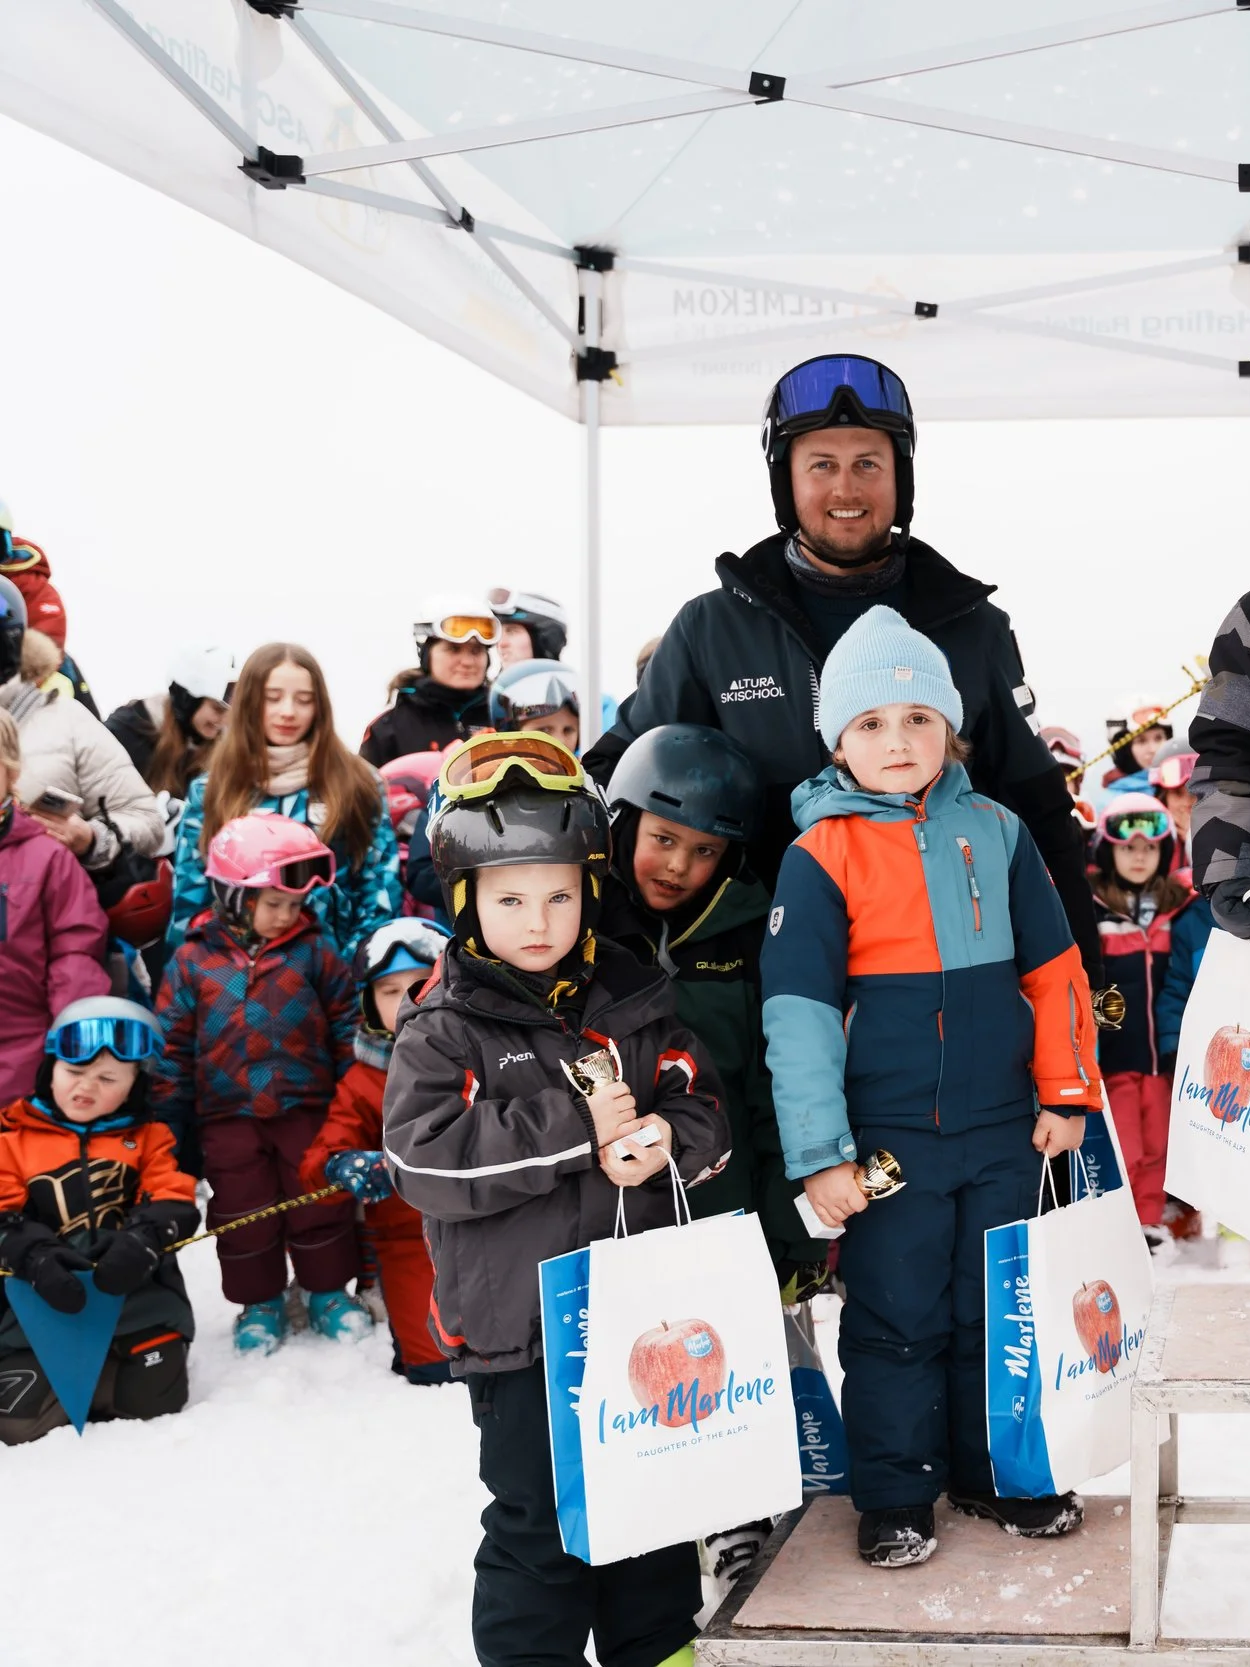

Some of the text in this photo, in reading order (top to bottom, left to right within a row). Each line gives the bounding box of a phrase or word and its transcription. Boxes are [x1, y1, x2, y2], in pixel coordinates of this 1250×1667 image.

[720, 686, 785, 703] SKISCHOOL
[730, 676, 775, 690] ALTURA
[1186, 1082, 1214, 1107] am
[1004, 1275, 1033, 1379] Marlene
[1067, 1353, 1097, 1379] am
[1097, 1323, 1143, 1378] Marlen
[612, 1403, 659, 1433] am
[666, 1370, 775, 1434] Marlene
[637, 1424, 749, 1458] DAUGHTER OF THE ALPS
